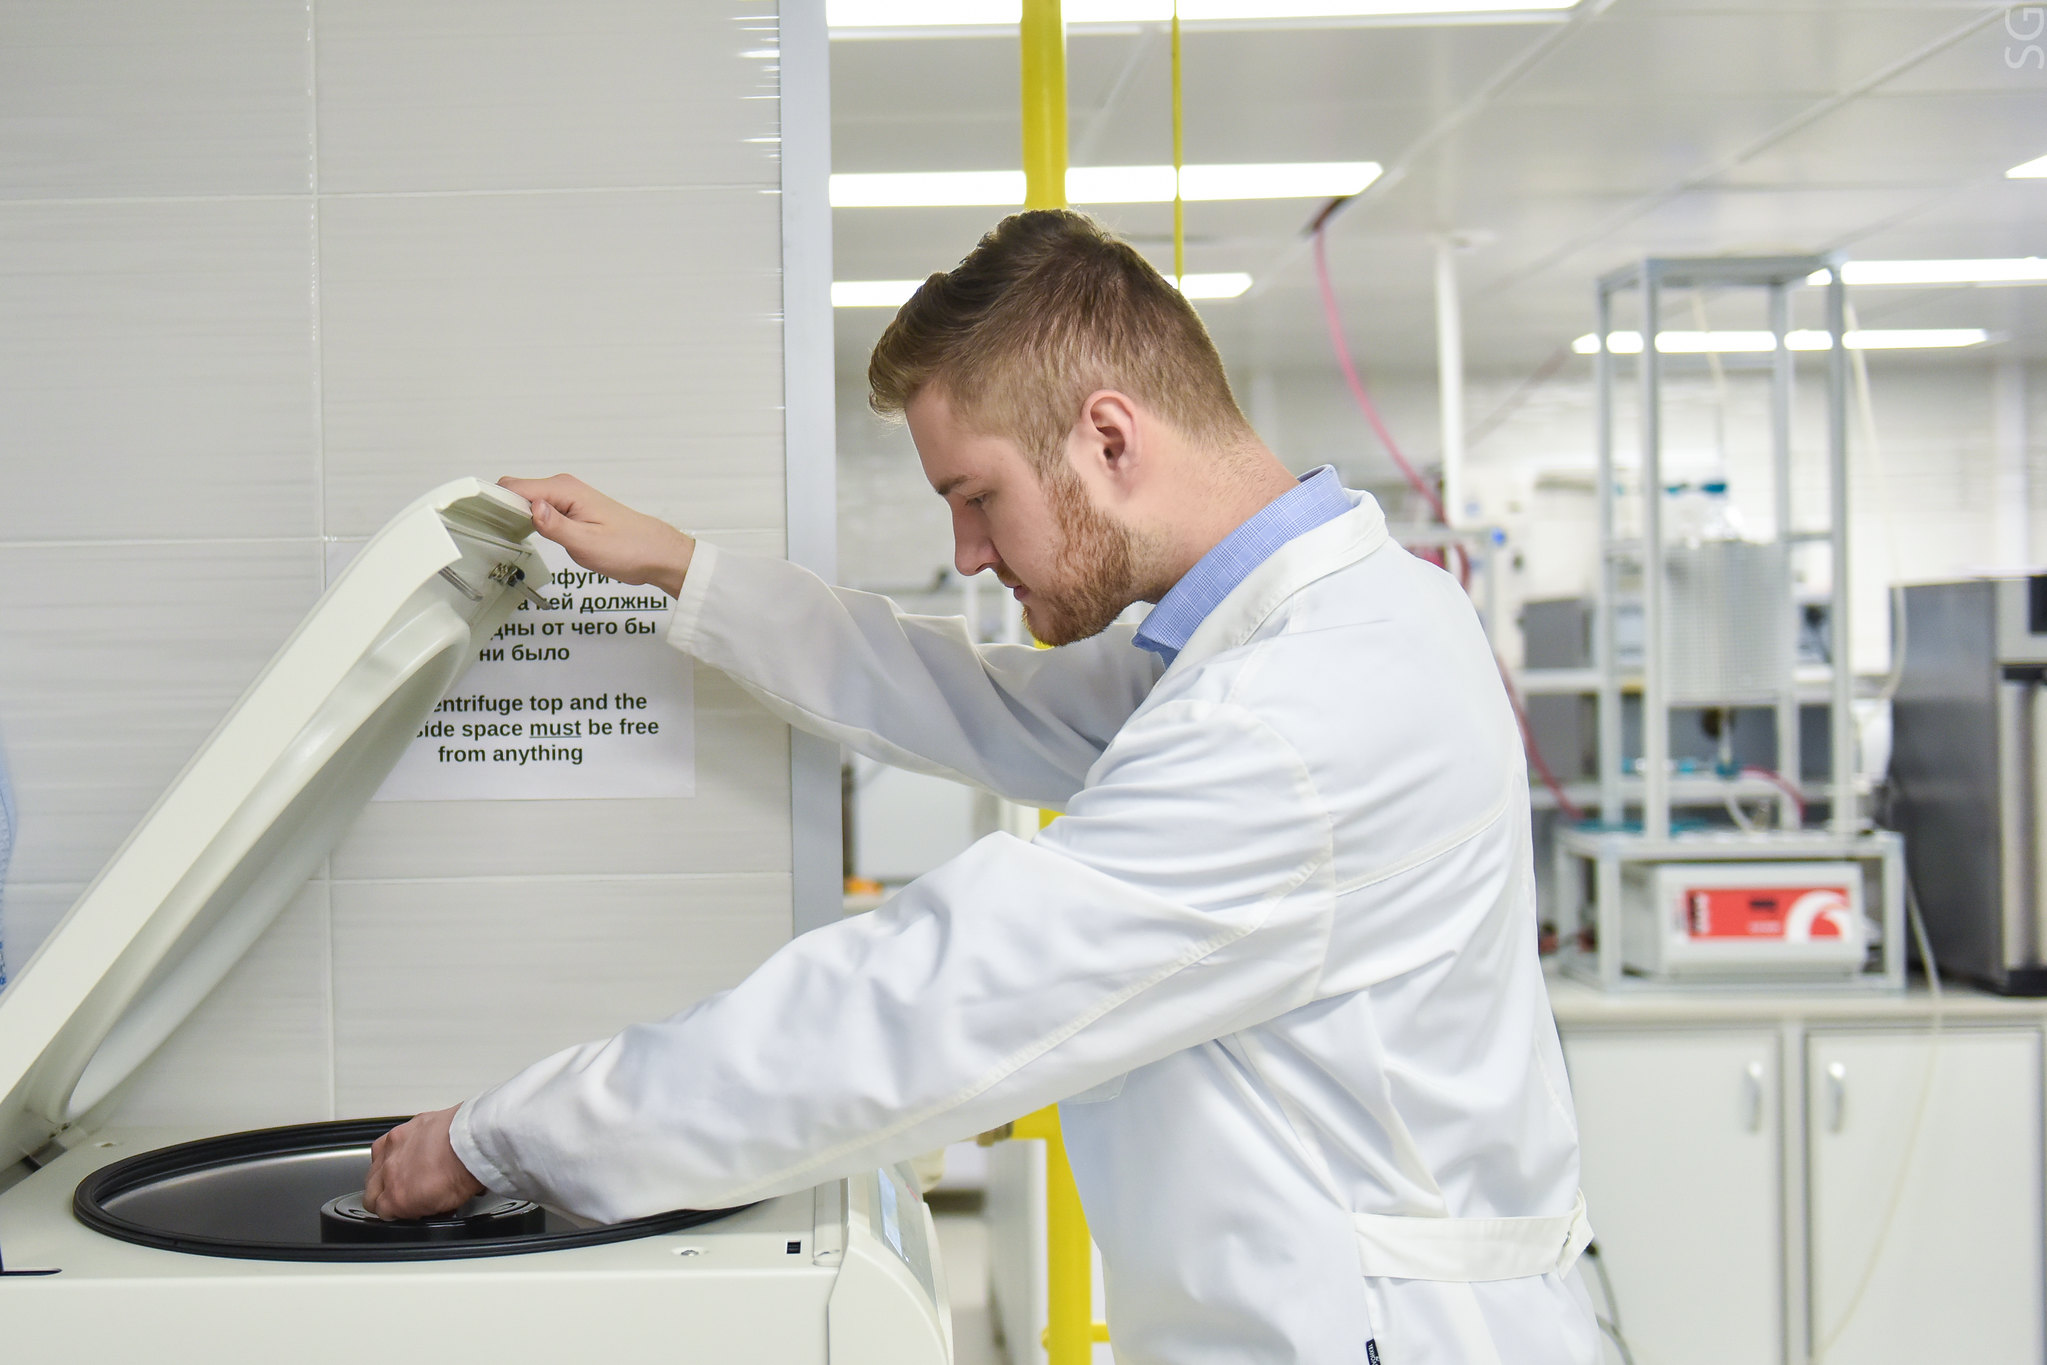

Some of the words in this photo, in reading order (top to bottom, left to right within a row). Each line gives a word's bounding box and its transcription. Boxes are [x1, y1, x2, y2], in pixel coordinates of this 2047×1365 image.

[580, 596, 668, 614] должны
[542, 622, 564, 636] от
[571, 622, 618, 635] чего
[625, 618, 656, 635] бы
[511, 645, 570, 661] было
[530, 696, 563, 714] top
[570, 694, 608, 710] and
[615, 693, 647, 709] the
[462, 723, 523, 741] space
[530, 720, 582, 738] must
[588, 719, 613, 735] be
[619, 718, 659, 735] free
[438, 746, 486, 763] from
[493, 744, 584, 765] anything
